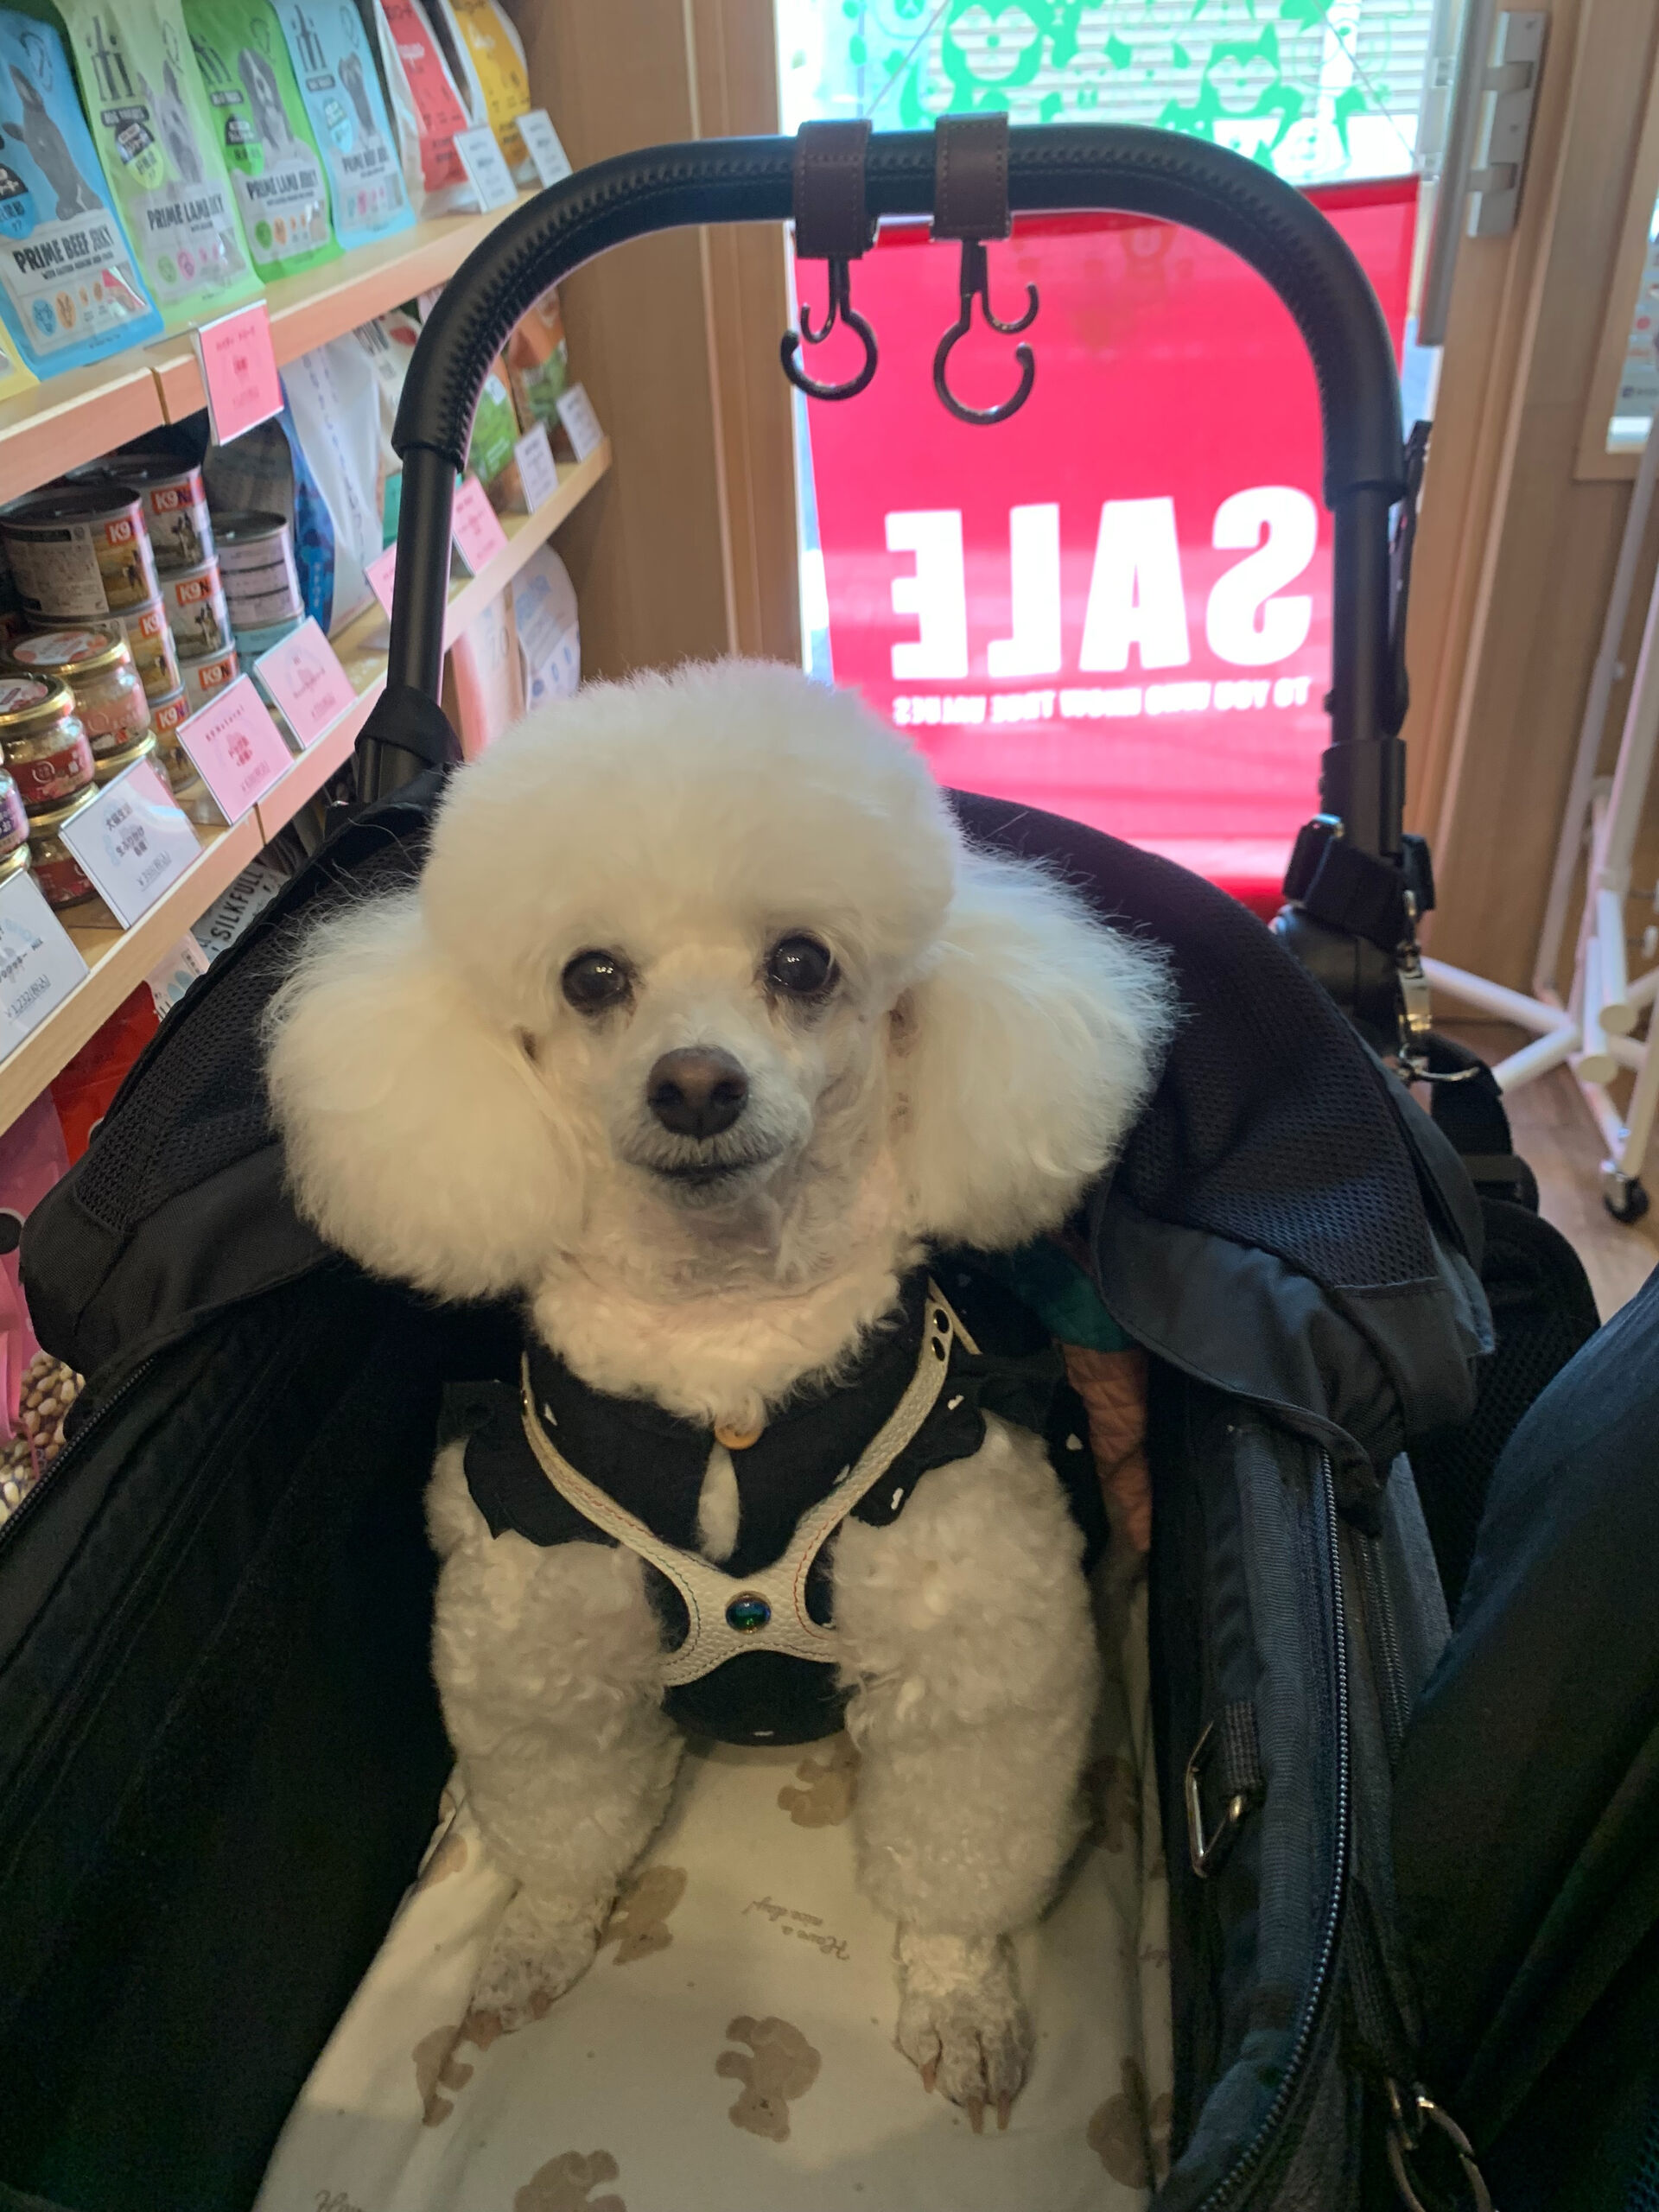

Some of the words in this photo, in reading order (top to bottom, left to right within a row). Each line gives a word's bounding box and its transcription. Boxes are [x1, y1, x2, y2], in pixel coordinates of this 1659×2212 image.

[147, 203, 183, 231] PRIME
[13, 239, 64, 274] PRIME
[61, 232, 90, 259] BEEF
